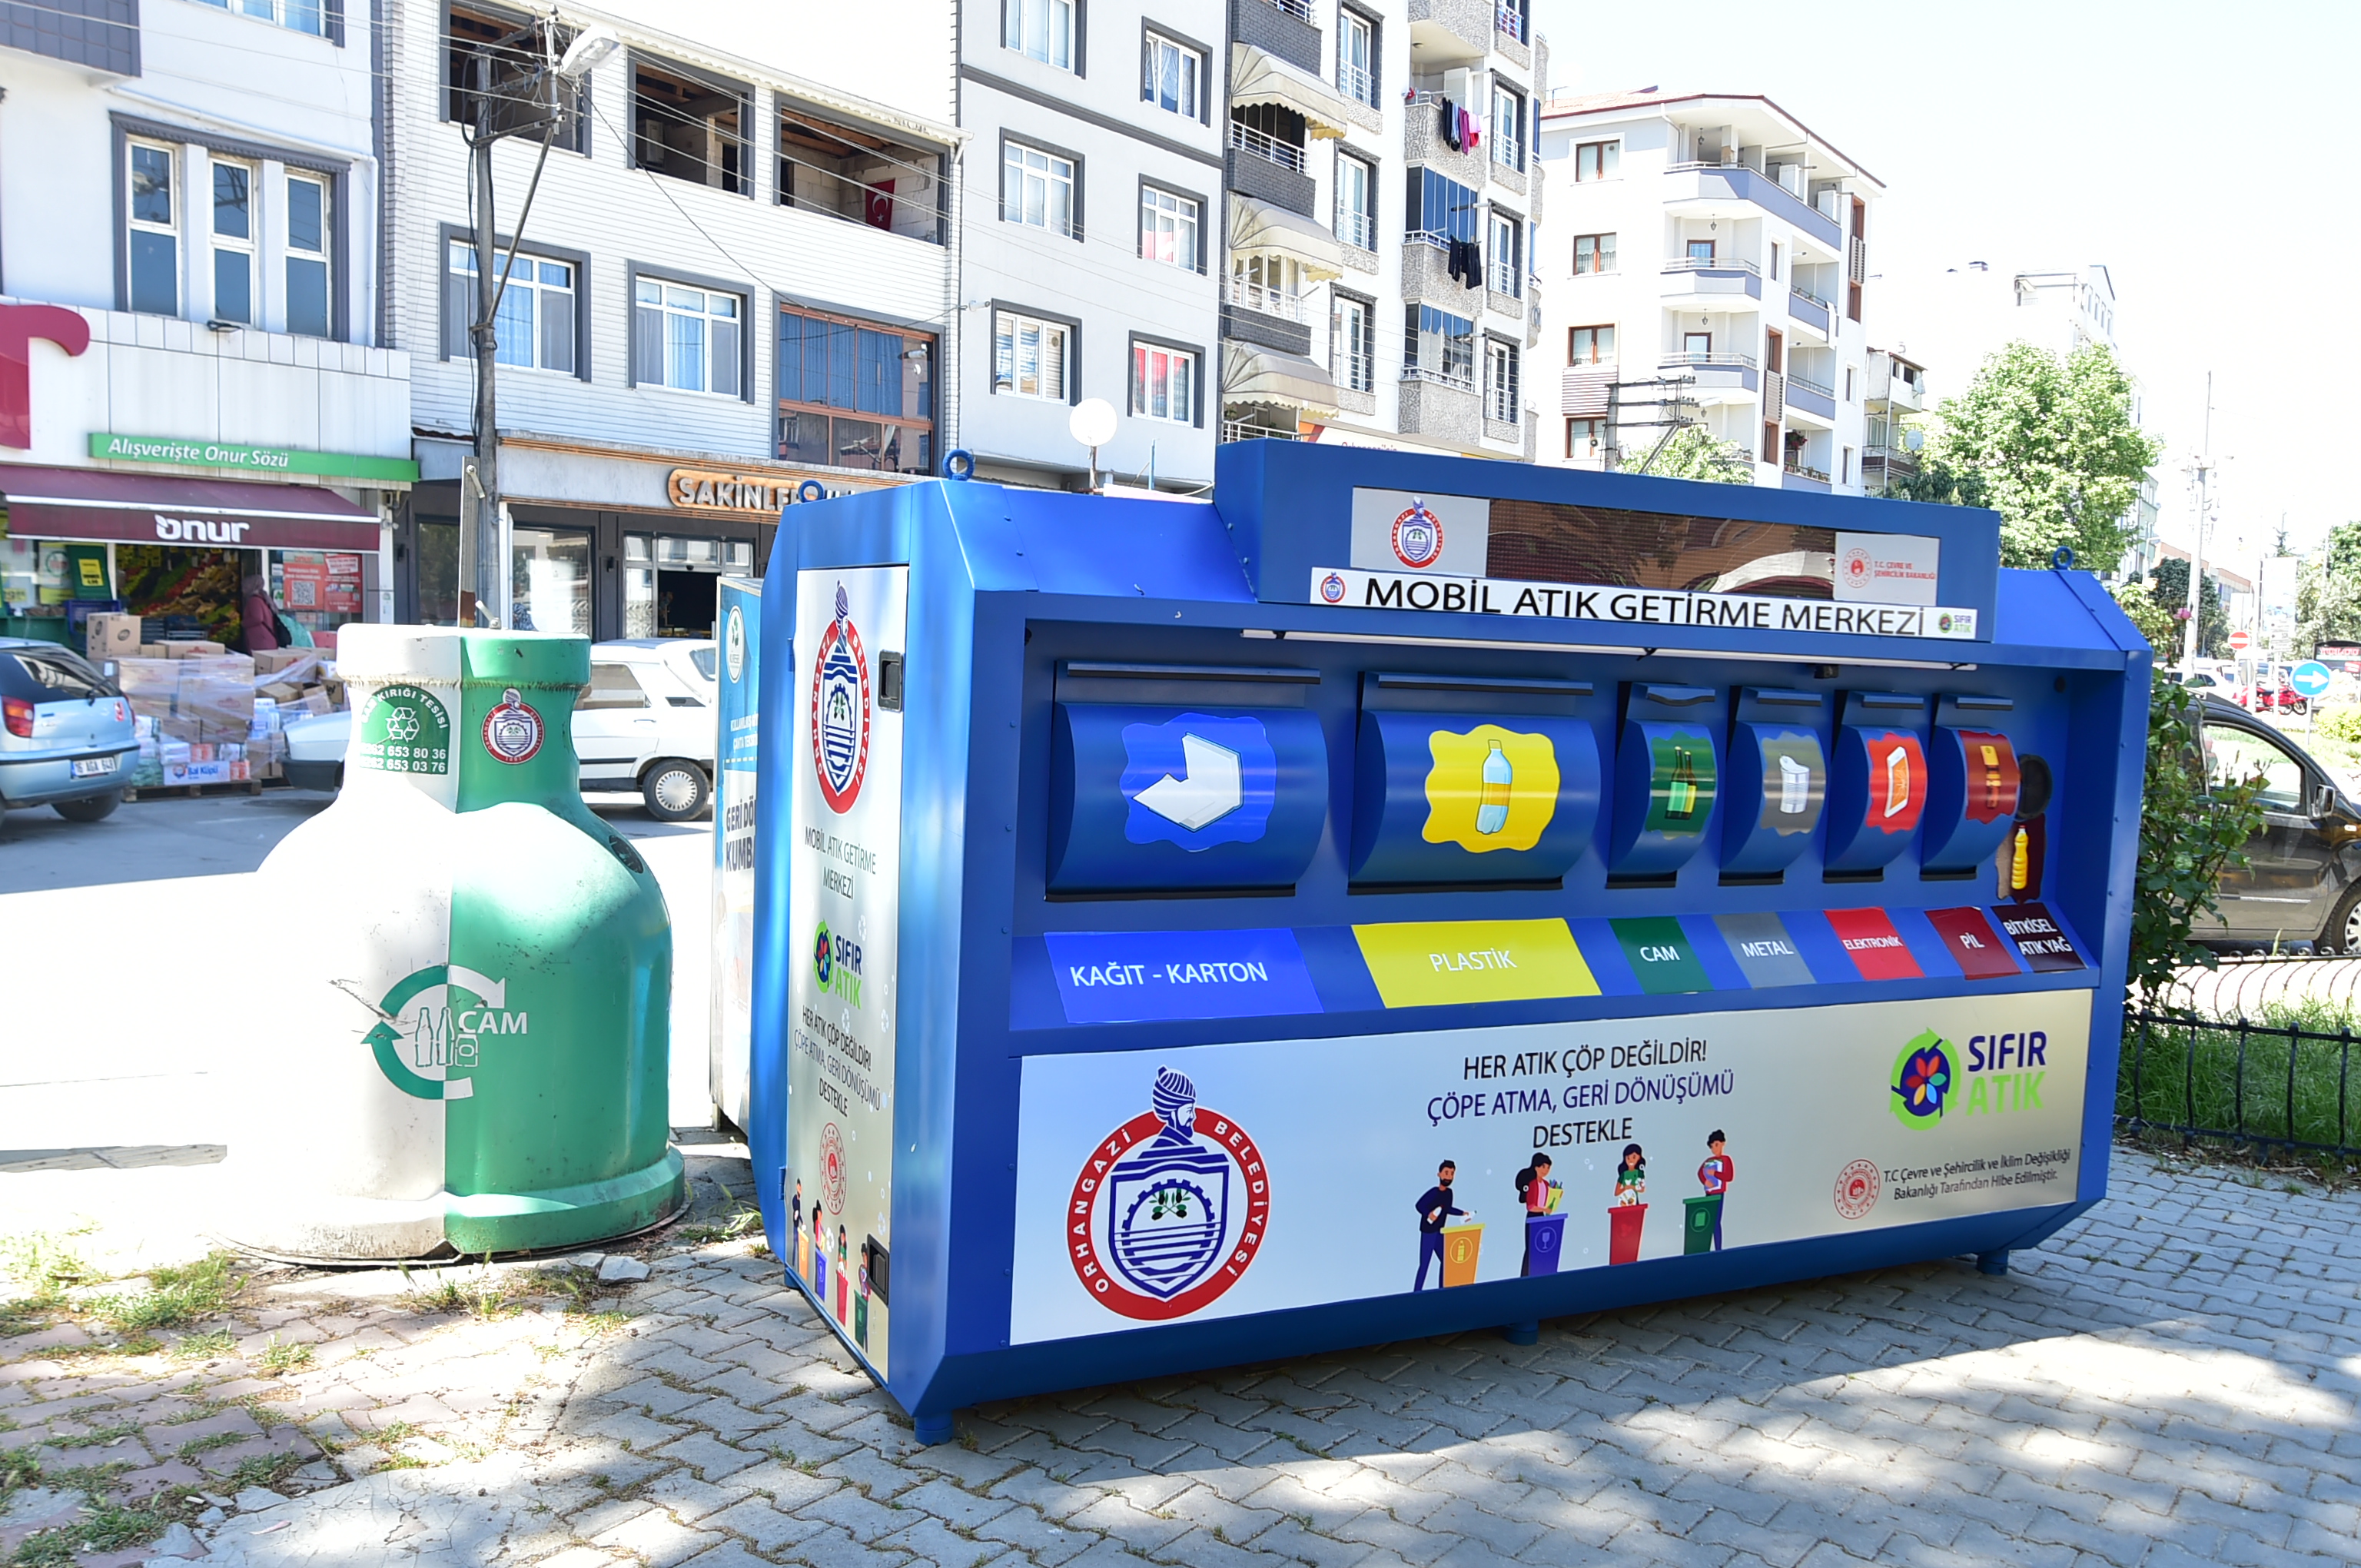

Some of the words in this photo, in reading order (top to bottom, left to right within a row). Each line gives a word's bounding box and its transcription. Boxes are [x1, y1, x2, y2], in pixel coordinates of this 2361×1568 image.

[108, 437, 200, 461] Alışverişte
[204, 445, 247, 463] Onur
[251, 450, 288, 467] Sözü
[154, 513, 250, 543] onur
[1365, 577, 1502, 614] MOBİL
[1512, 588, 1601, 619] ATIK
[1609, 592, 1770, 629] GETİRME
[1781, 603, 1924, 636] MERKEZİ
[377, 688, 417, 702] KIRIĞI
[812, 633, 831, 775] ORHANGAZİ
[852, 634, 868, 788] BELEDİYESİ
[387, 745, 410, 757] 653
[413, 747, 429, 758] 80
[432, 749, 447, 759] 36
[387, 759, 409, 770] 653
[413, 760, 427, 771] 03
[431, 762, 446, 772] 76
[726, 799, 742, 832] GERİ
[743, 795, 756, 828] DÖ
[726, 836, 755, 872] KUMB
[805, 826, 826, 853] MOBİL
[827, 835, 842, 861] ATIK
[844, 842, 876, 875] GETİRME
[823, 866, 854, 900] MERKEZİ
[1842, 935, 1904, 951] ELEKTRONİK
[1959, 932, 1985, 949] PİL
[2003, 918, 2057, 935] BİTKİSEL
[835, 934, 862, 975] SIFIR
[1428, 947, 1518, 972] PLASTİK
[1639, 945, 1680, 962] CAM
[1741, 940, 1795, 957] METAL
[2018, 941, 2044, 955] ATIK
[2044, 936, 2073, 952] YAĞ
[835, 966, 862, 1010] ATIK
[1070, 961, 1144, 987] KAĞIT
[1166, 962, 1268, 984] KARTON
[458, 1011, 527, 1035] CAM
[802, 1005, 813, 1028] HER
[814, 1014, 827, 1039] ATIK
[827, 1022, 839, 1048] ÇÖP
[840, 1035, 872, 1072] DEĞİLDİR!
[1463, 1055, 1506, 1081] HER
[1511, 1050, 1559, 1076] ATIK
[1561, 1045, 1605, 1078] ÇÖP
[1610, 1037, 1707, 1069] DEĞİLDİR!
[1968, 1031, 2047, 1072] SIFIR
[794, 1028, 809, 1055] ÇÖPE
[809, 1041, 826, 1071] ATMA,
[827, 1055, 841, 1080] GERİ
[842, 1065, 881, 1111] DÖNÜŞÜMÜ
[819, 1078, 848, 1118] DESTEKLE
[1426, 1091, 1486, 1127] ÇÖPE
[1491, 1088, 1558, 1116] ATMA,
[1562, 1078, 1609, 1109] GERİ
[1614, 1068, 1734, 1105] DÖNÜŞÜMÜ
[1966, 1071, 2046, 1117] ATIK
[1532, 1117, 1633, 1148] DESTEKLE
[1900, 1168, 1928, 1184] Çevre
[1930, 1167, 1942, 1177] ve
[1944, 1158, 1986, 1178] Şehircilik
[1987, 1161, 1998, 1170] ve
[2000, 1154, 2023, 1168] İklim
[2024, 1148, 2071, 1168] Değişikliği
[1894, 1184, 1938, 1200] Bakanlığı
[1940, 1176, 1989, 1194] Tarafından
[1991, 1173, 2013, 1186] Hibe
[2014, 1168, 2058, 1184] Edilmiştir.
[1073, 1128, 1131, 1293] ORHANGAZİ
[1214, 1120, 1267, 1277] BELEDİYESİ
